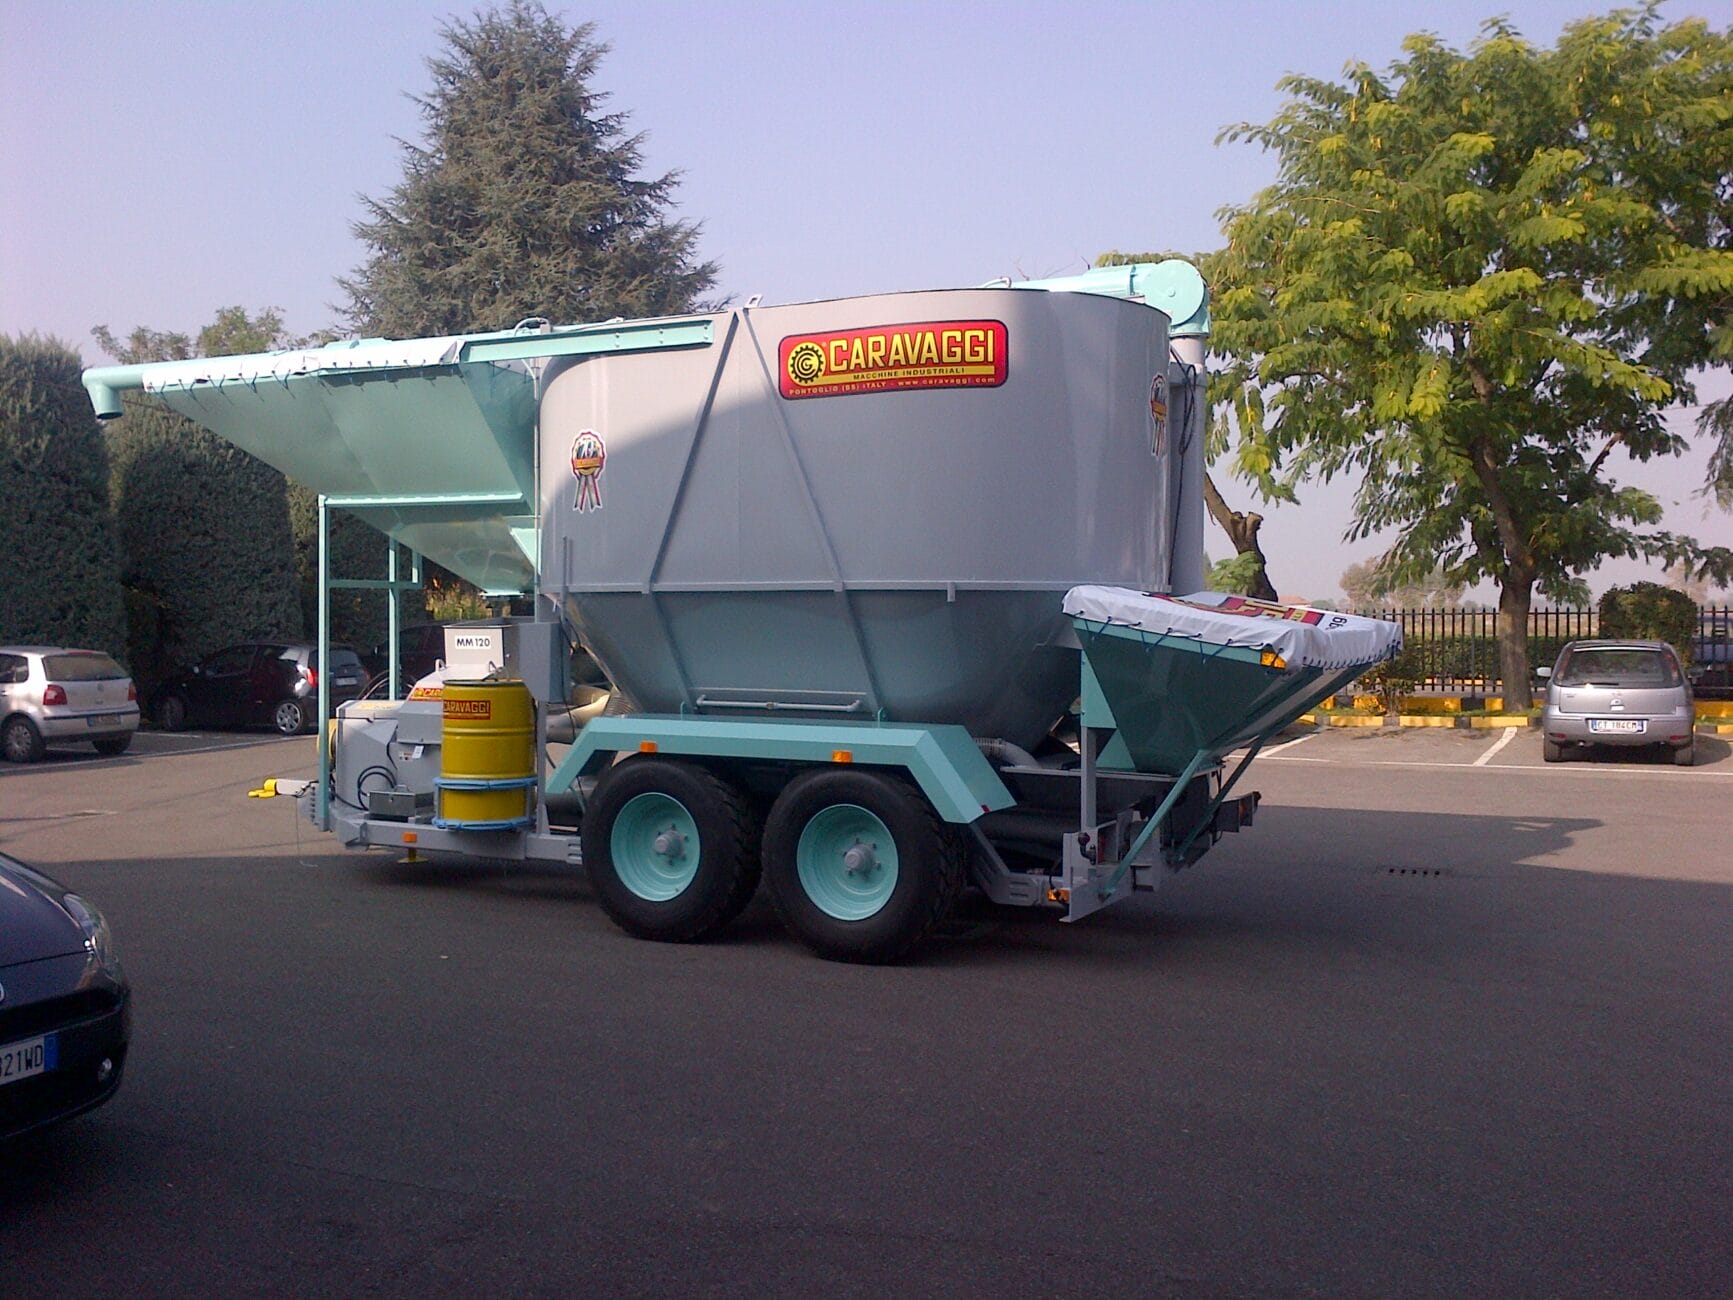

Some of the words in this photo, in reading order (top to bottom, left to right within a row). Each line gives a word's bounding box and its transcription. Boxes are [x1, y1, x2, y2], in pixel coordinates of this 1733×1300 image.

[829, 329, 994, 372] CARAVAGGI
[853, 370, 899, 380] MACCHINE
[902, 367, 965, 377] INDUSTRIALI
[863, 380, 887, 389] ITALY
[456, 638, 474, 647] MM
[475, 638, 491, 647] 120
[0, 1045, 43, 1077] 21WD
